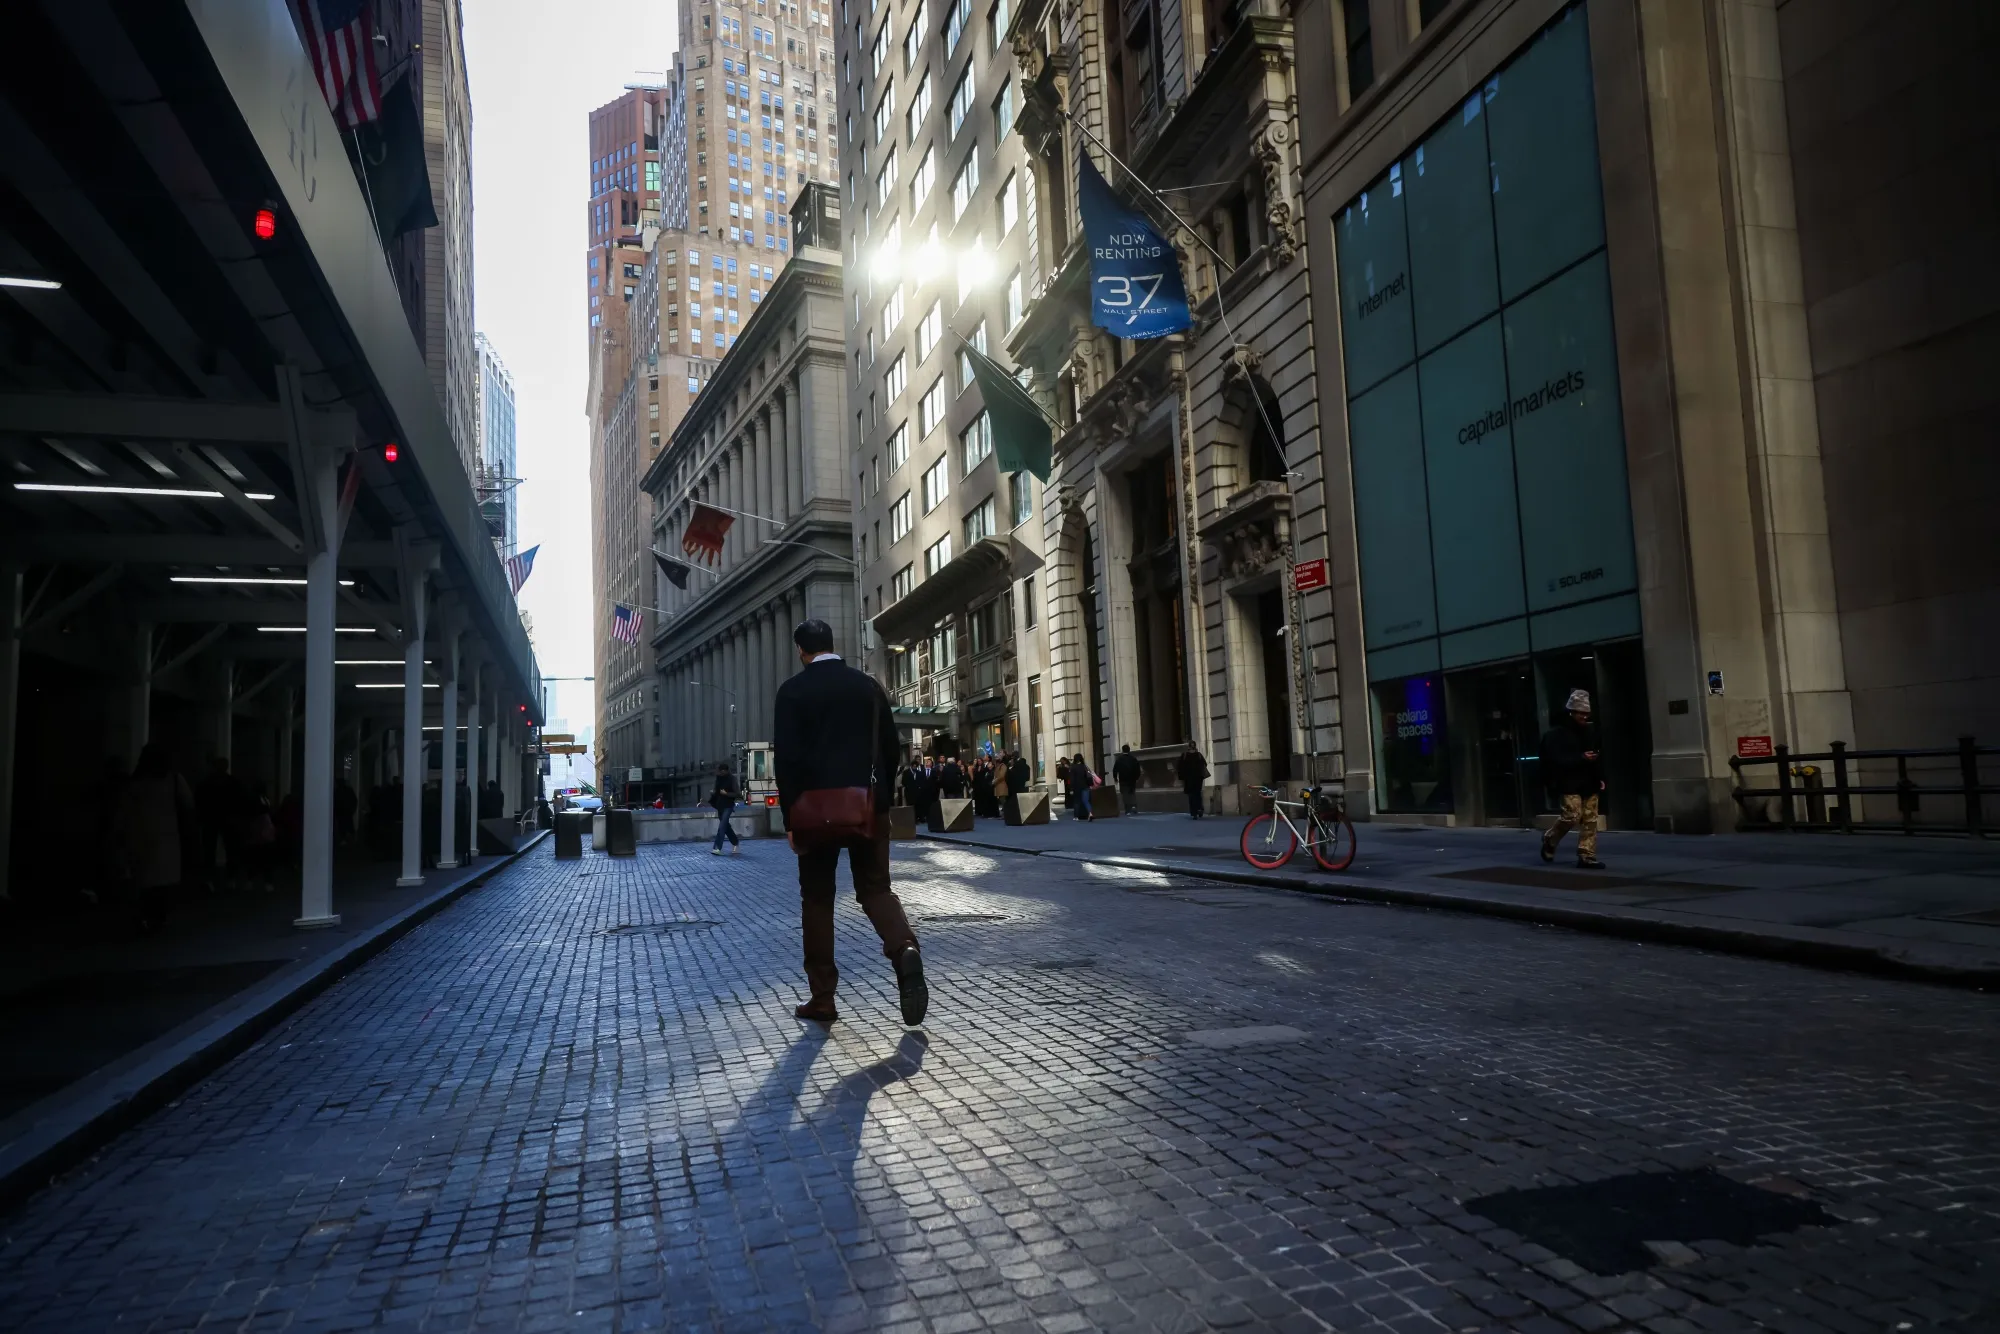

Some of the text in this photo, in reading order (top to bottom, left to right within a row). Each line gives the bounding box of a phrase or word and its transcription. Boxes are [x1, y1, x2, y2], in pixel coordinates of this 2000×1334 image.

[1109, 234, 1145, 246] NOW
[1095, 247, 1161, 259] RENTING
[1097, 273, 1164, 325] 37
[1358, 271, 1405, 321] Internet
[1102, 307, 1168, 315] WALL STREET
[1458, 370, 1584, 445] capital markets
[1559, 568, 1603, 588] SOLANA
[1396, 708, 1428, 724] solana
[1398, 723, 1433, 741] spaces
